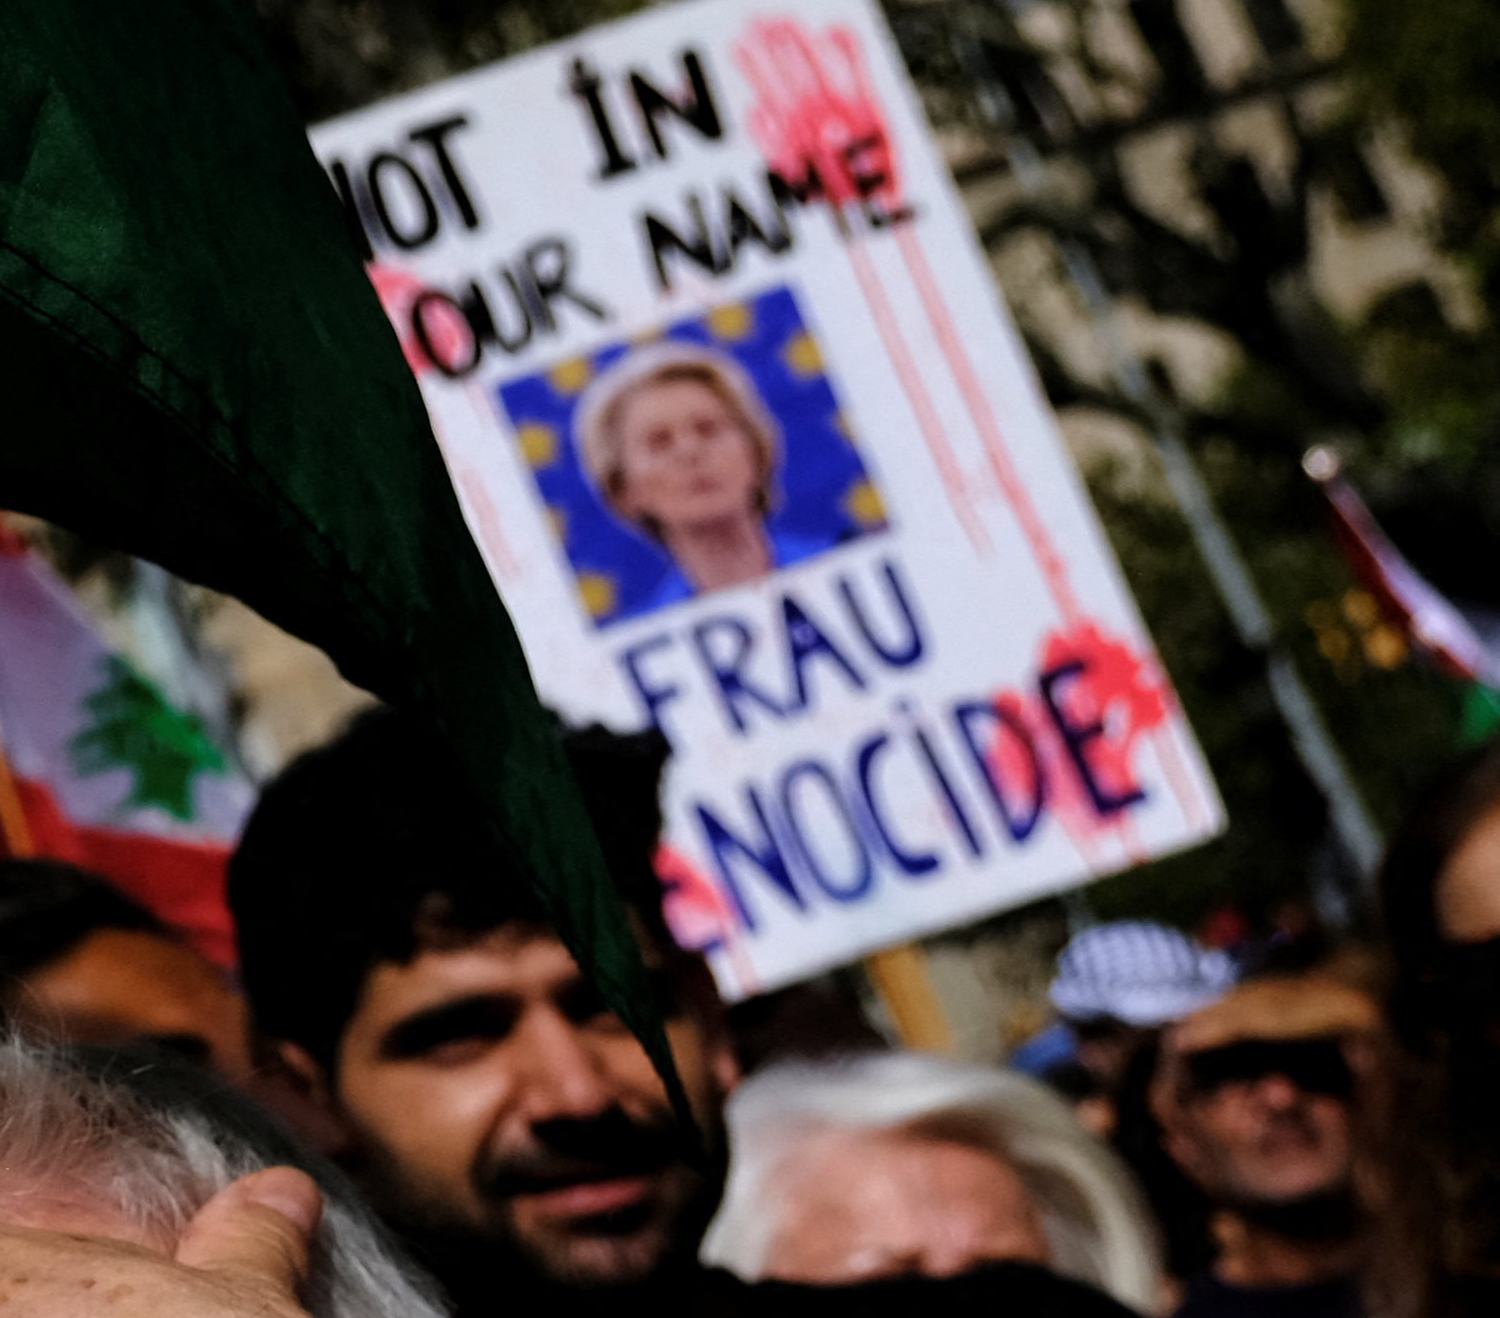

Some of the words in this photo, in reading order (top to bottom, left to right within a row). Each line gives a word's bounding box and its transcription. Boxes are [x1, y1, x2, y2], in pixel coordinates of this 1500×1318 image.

[412, 237, 606, 378] OUR
[646, 130, 916, 290] NAME
[621, 562, 923, 754] FRAU
